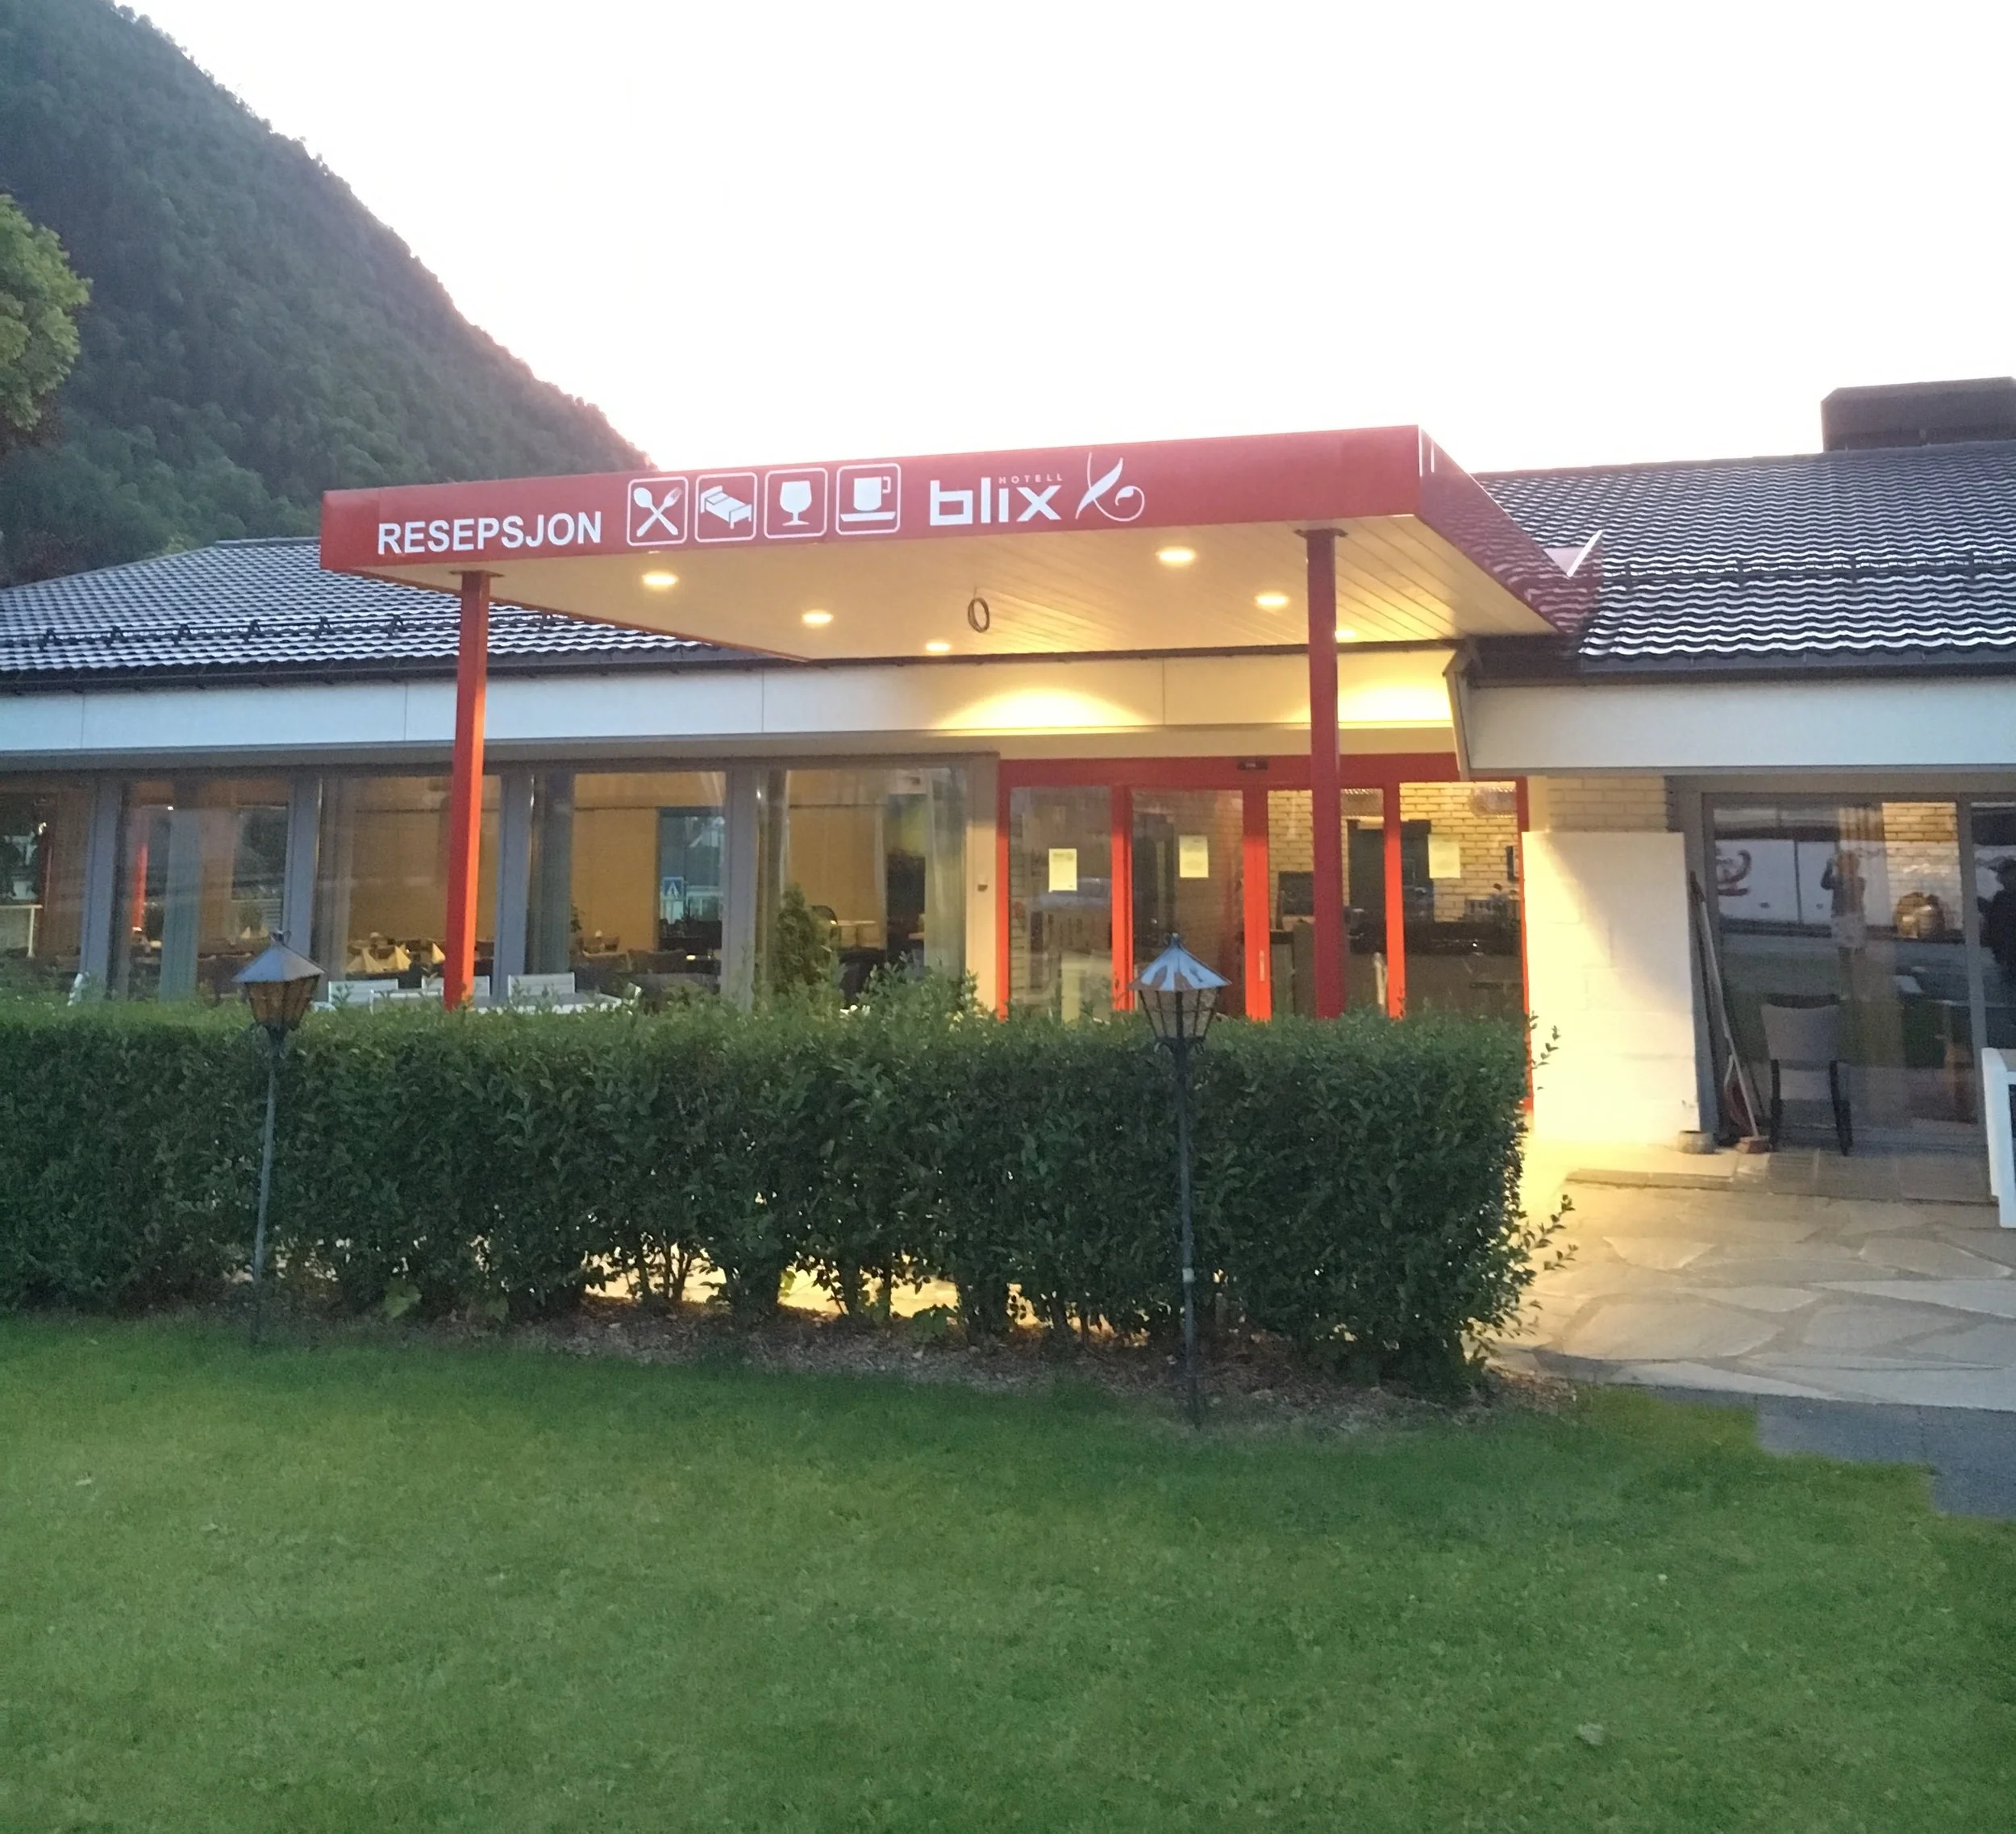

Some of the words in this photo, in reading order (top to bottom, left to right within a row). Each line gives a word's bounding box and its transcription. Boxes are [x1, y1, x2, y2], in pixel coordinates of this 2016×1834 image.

[998, 473, 1064, 485] HOTELL
[929, 477, 1062, 527] blix
[377, 511, 602, 556] RESEPSJON
